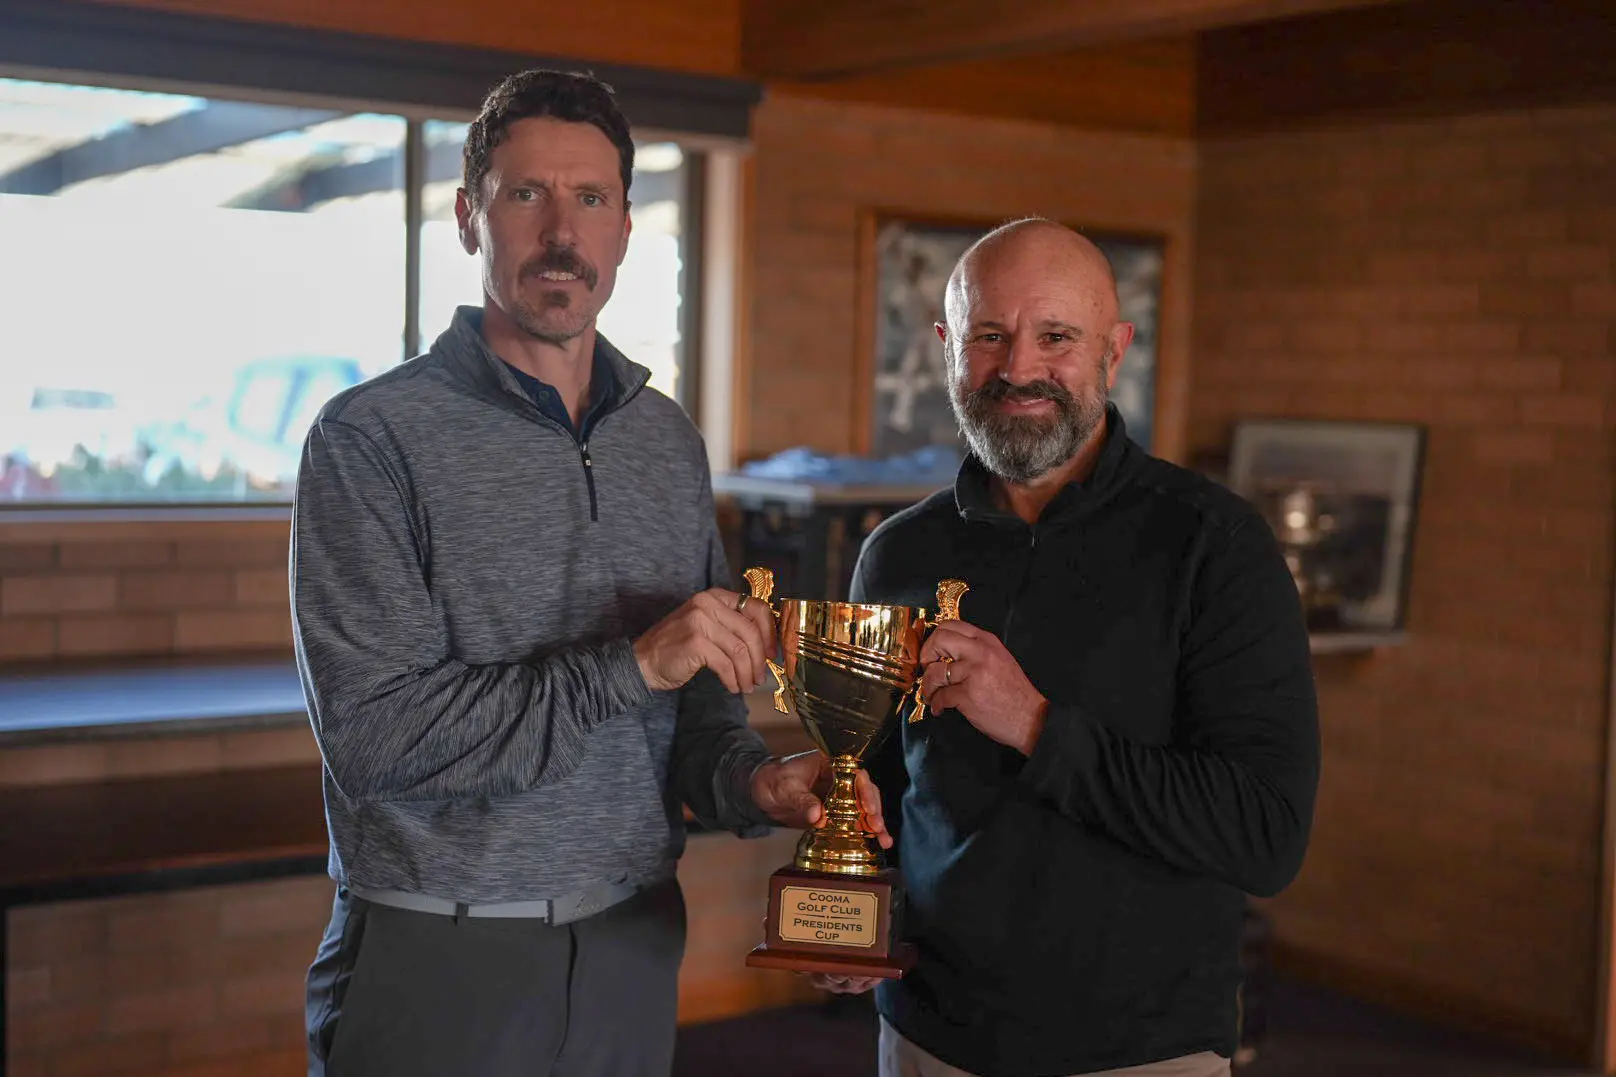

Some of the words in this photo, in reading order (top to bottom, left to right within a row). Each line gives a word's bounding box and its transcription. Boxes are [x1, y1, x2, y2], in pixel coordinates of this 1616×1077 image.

[808, 892, 850, 904] COOMA
[797, 902, 828, 913] GOLF
[830, 904, 861, 916] CLUB
[793, 918, 863, 932] PRESIDENTS
[815, 930, 840, 941] CUP
